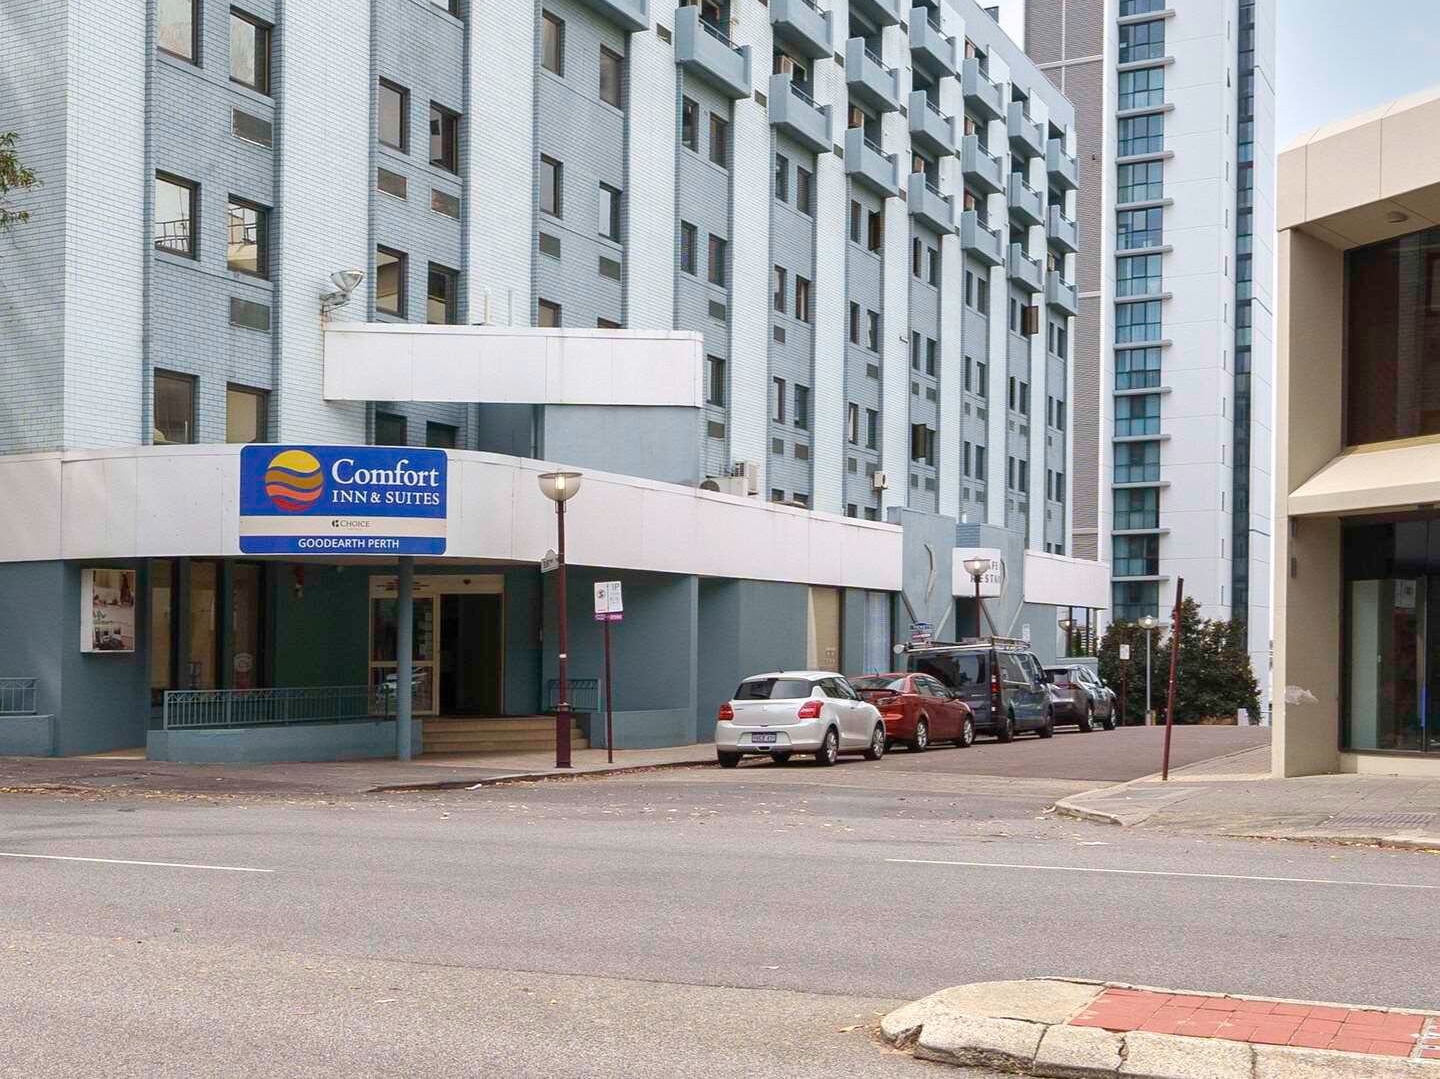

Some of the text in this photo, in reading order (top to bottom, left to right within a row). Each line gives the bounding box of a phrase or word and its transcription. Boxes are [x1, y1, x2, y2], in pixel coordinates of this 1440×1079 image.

[331, 458, 439, 487] Comfort
[332, 489, 440, 505] INN & SUITES
[298, 537, 400, 548] GOODEARTH PERTH
